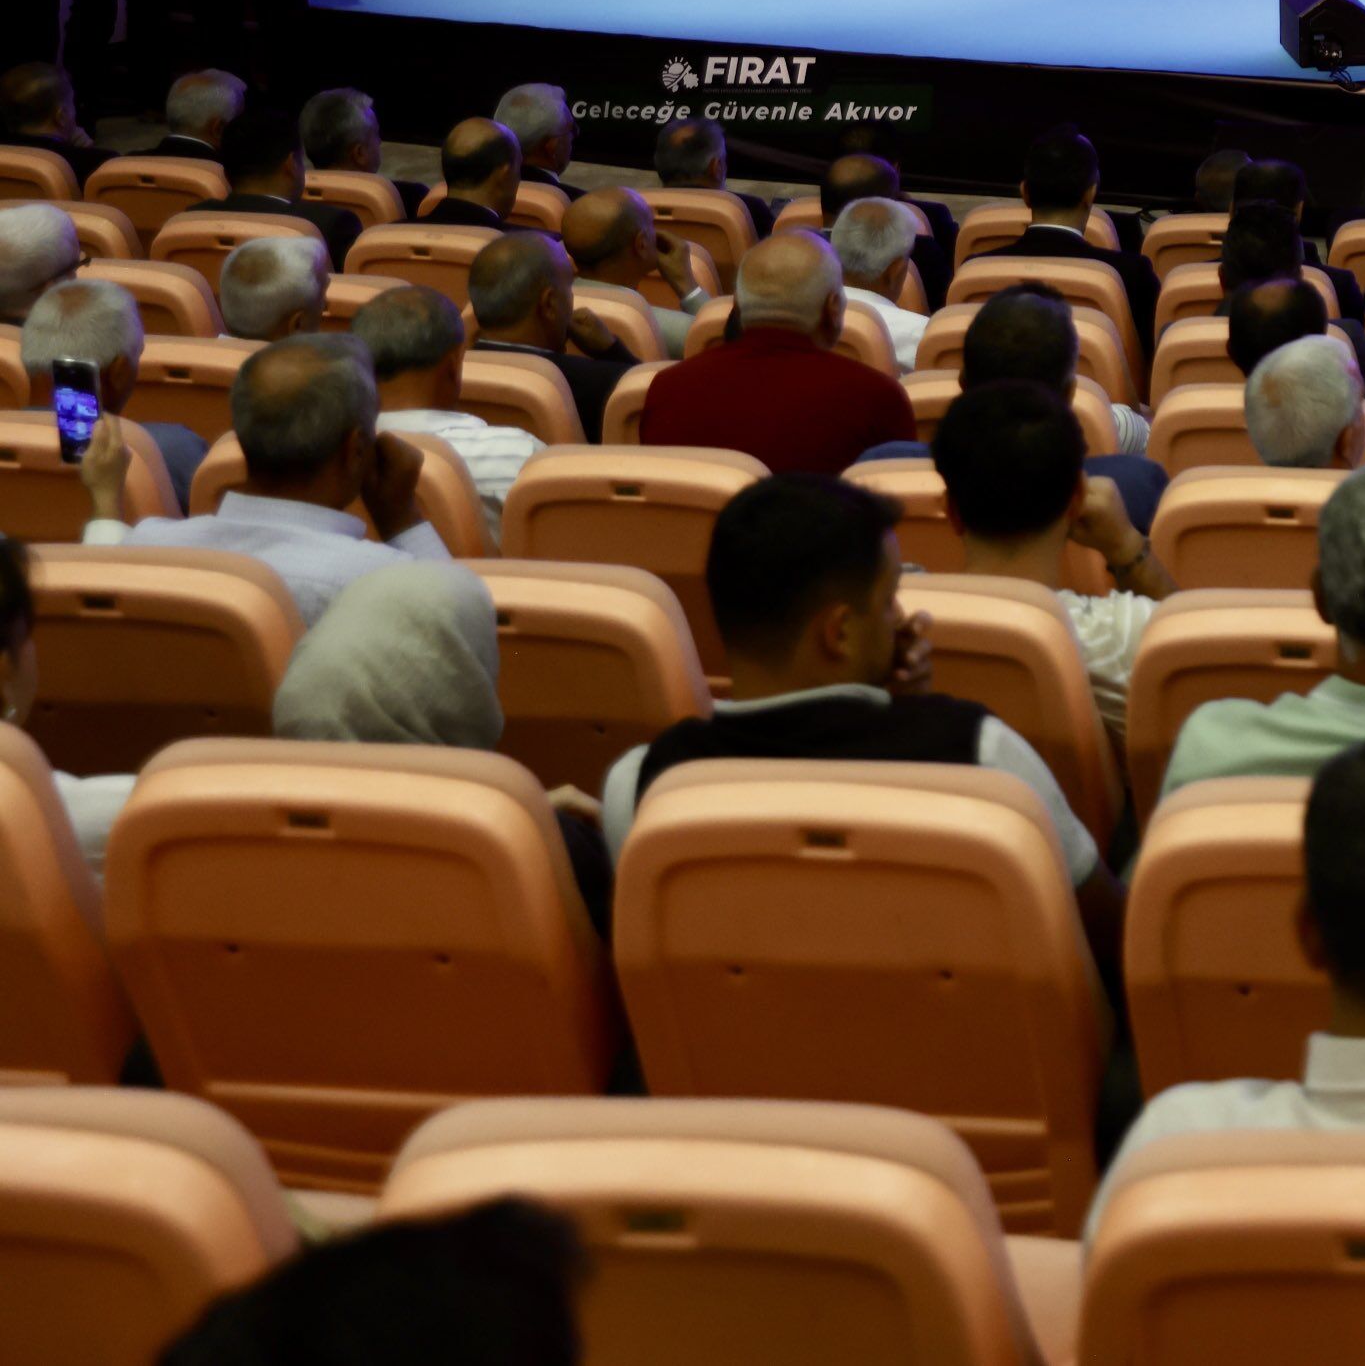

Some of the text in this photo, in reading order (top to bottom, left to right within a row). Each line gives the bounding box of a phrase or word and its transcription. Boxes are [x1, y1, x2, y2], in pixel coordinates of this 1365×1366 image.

[704, 56, 816, 85] FIRAT
[571, 100, 691, 124] Geleceğe
[704, 101, 813, 121] Güvenle
